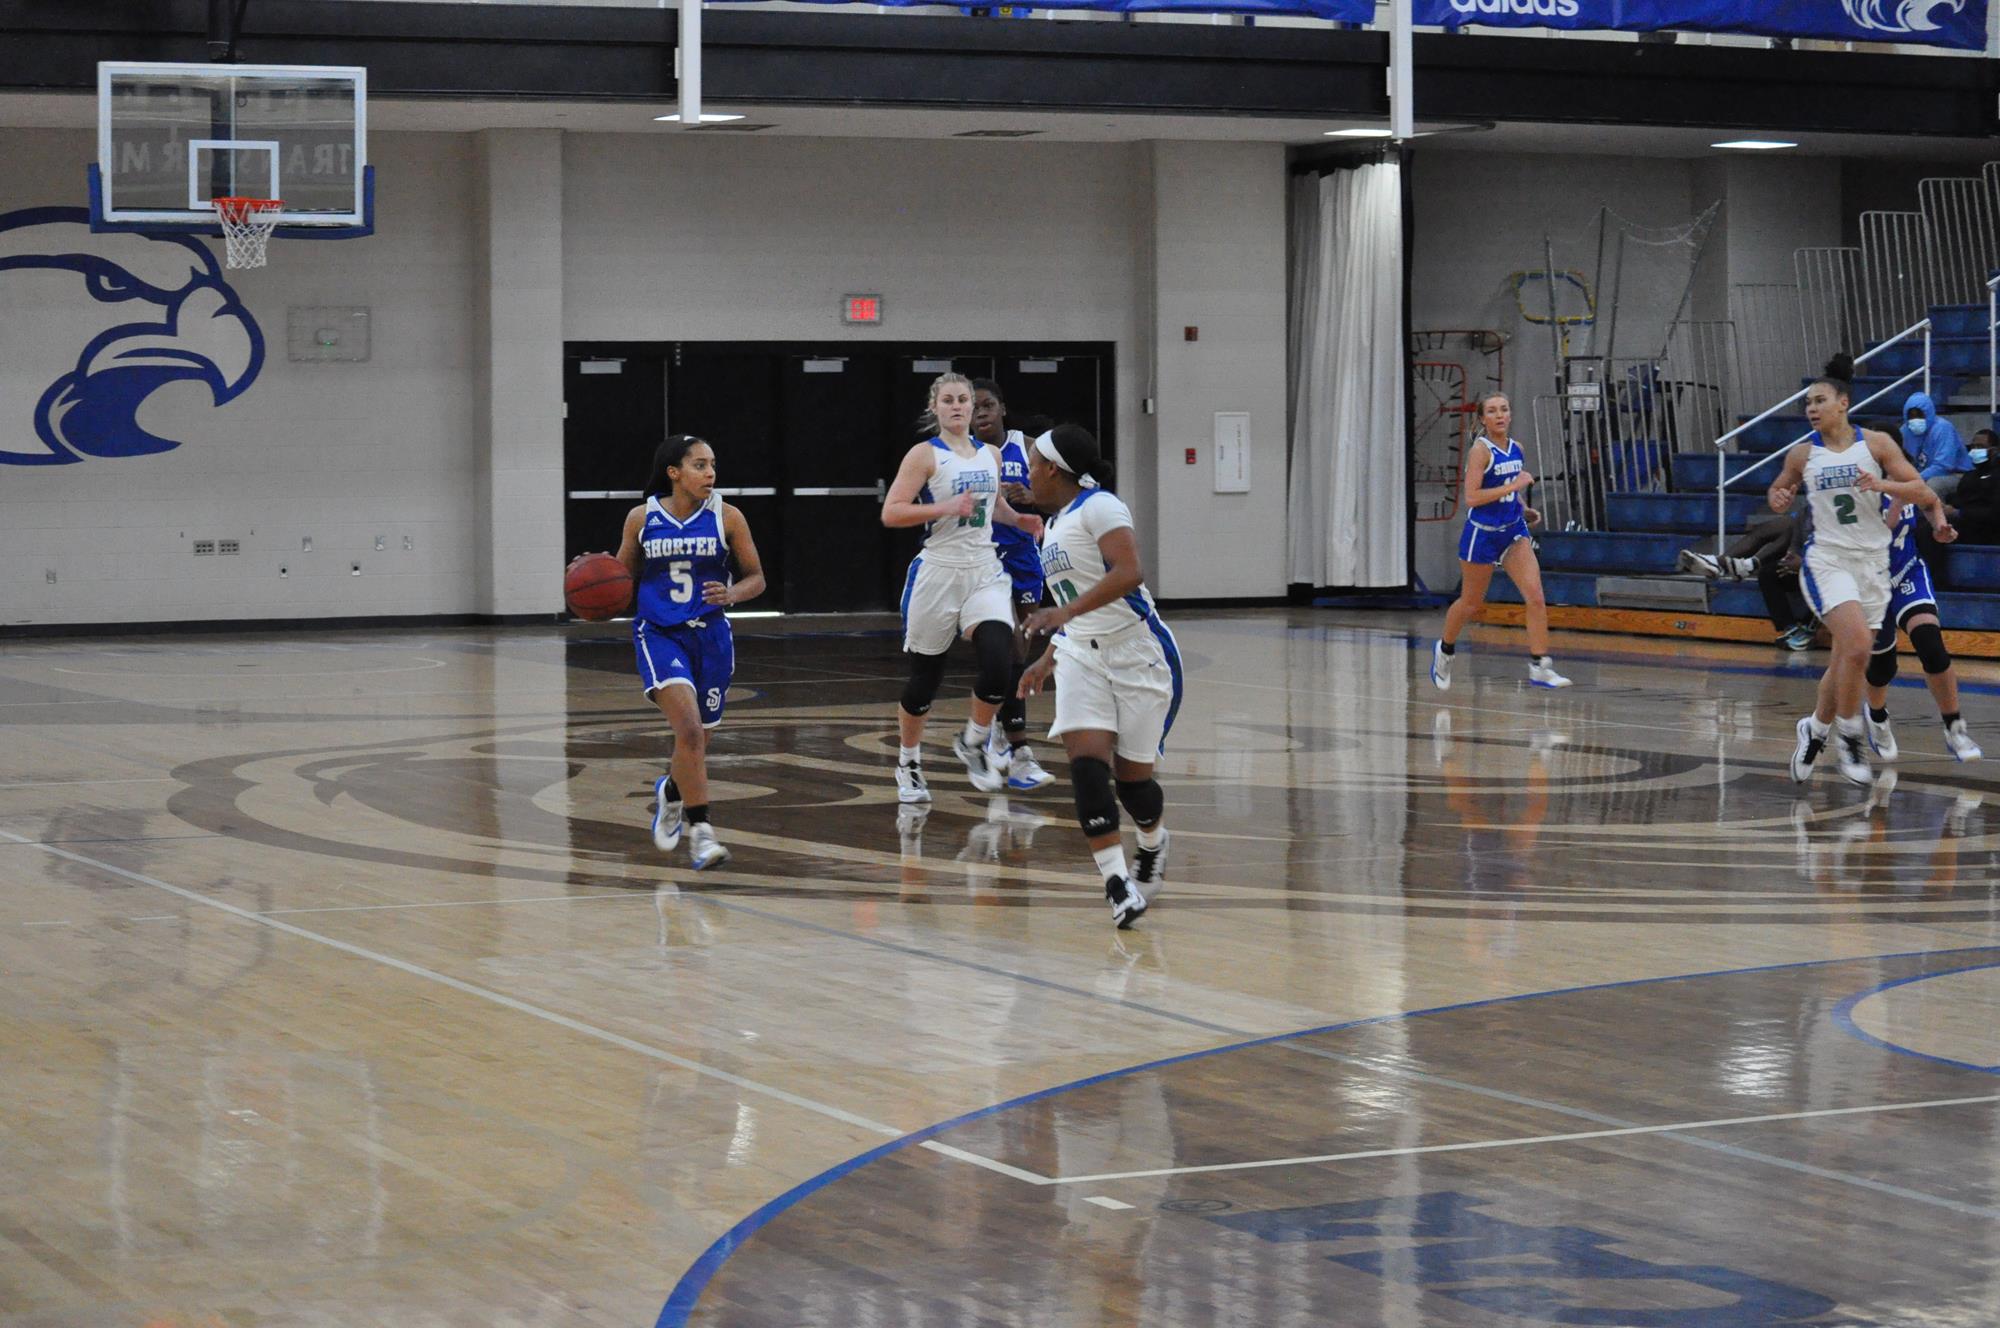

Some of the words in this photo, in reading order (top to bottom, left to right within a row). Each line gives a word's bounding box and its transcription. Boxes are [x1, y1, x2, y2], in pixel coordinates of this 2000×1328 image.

[1822, 464, 1857, 478] WEST
[1834, 494, 1857, 524] 2
[643, 537, 717, 558] SHORTER
[669, 561, 693, 603] 5
